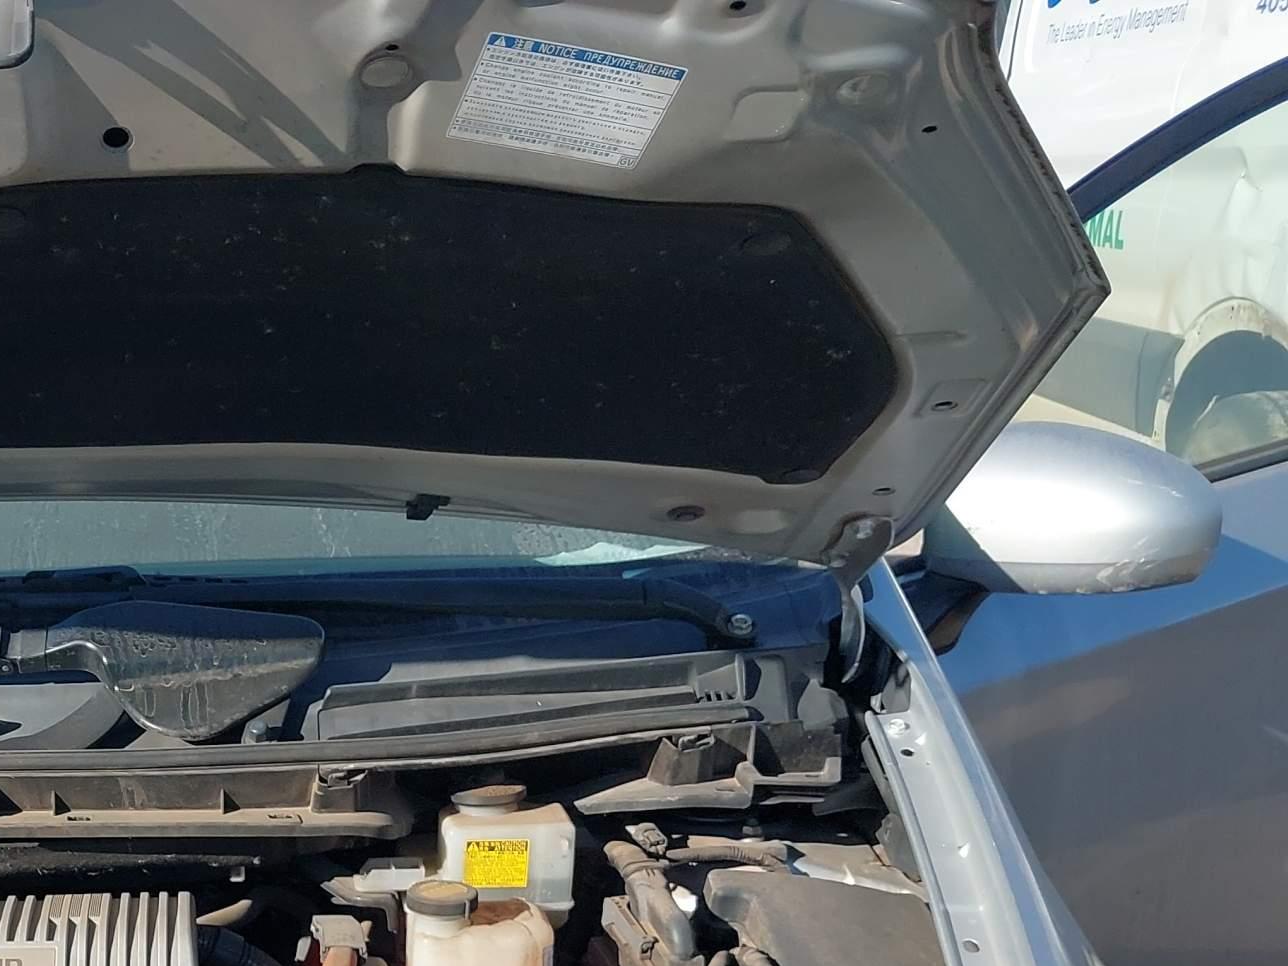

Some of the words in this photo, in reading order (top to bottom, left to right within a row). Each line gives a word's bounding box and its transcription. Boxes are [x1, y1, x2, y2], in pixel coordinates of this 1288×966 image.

[1096, 14, 1126, 39] Energy
[1126, 3, 1189, 33] Management
[538, 43, 578, 58] NOTICE
[583, 51, 680, 79] ПРЕДУПРЕЖДЕНИЕ
